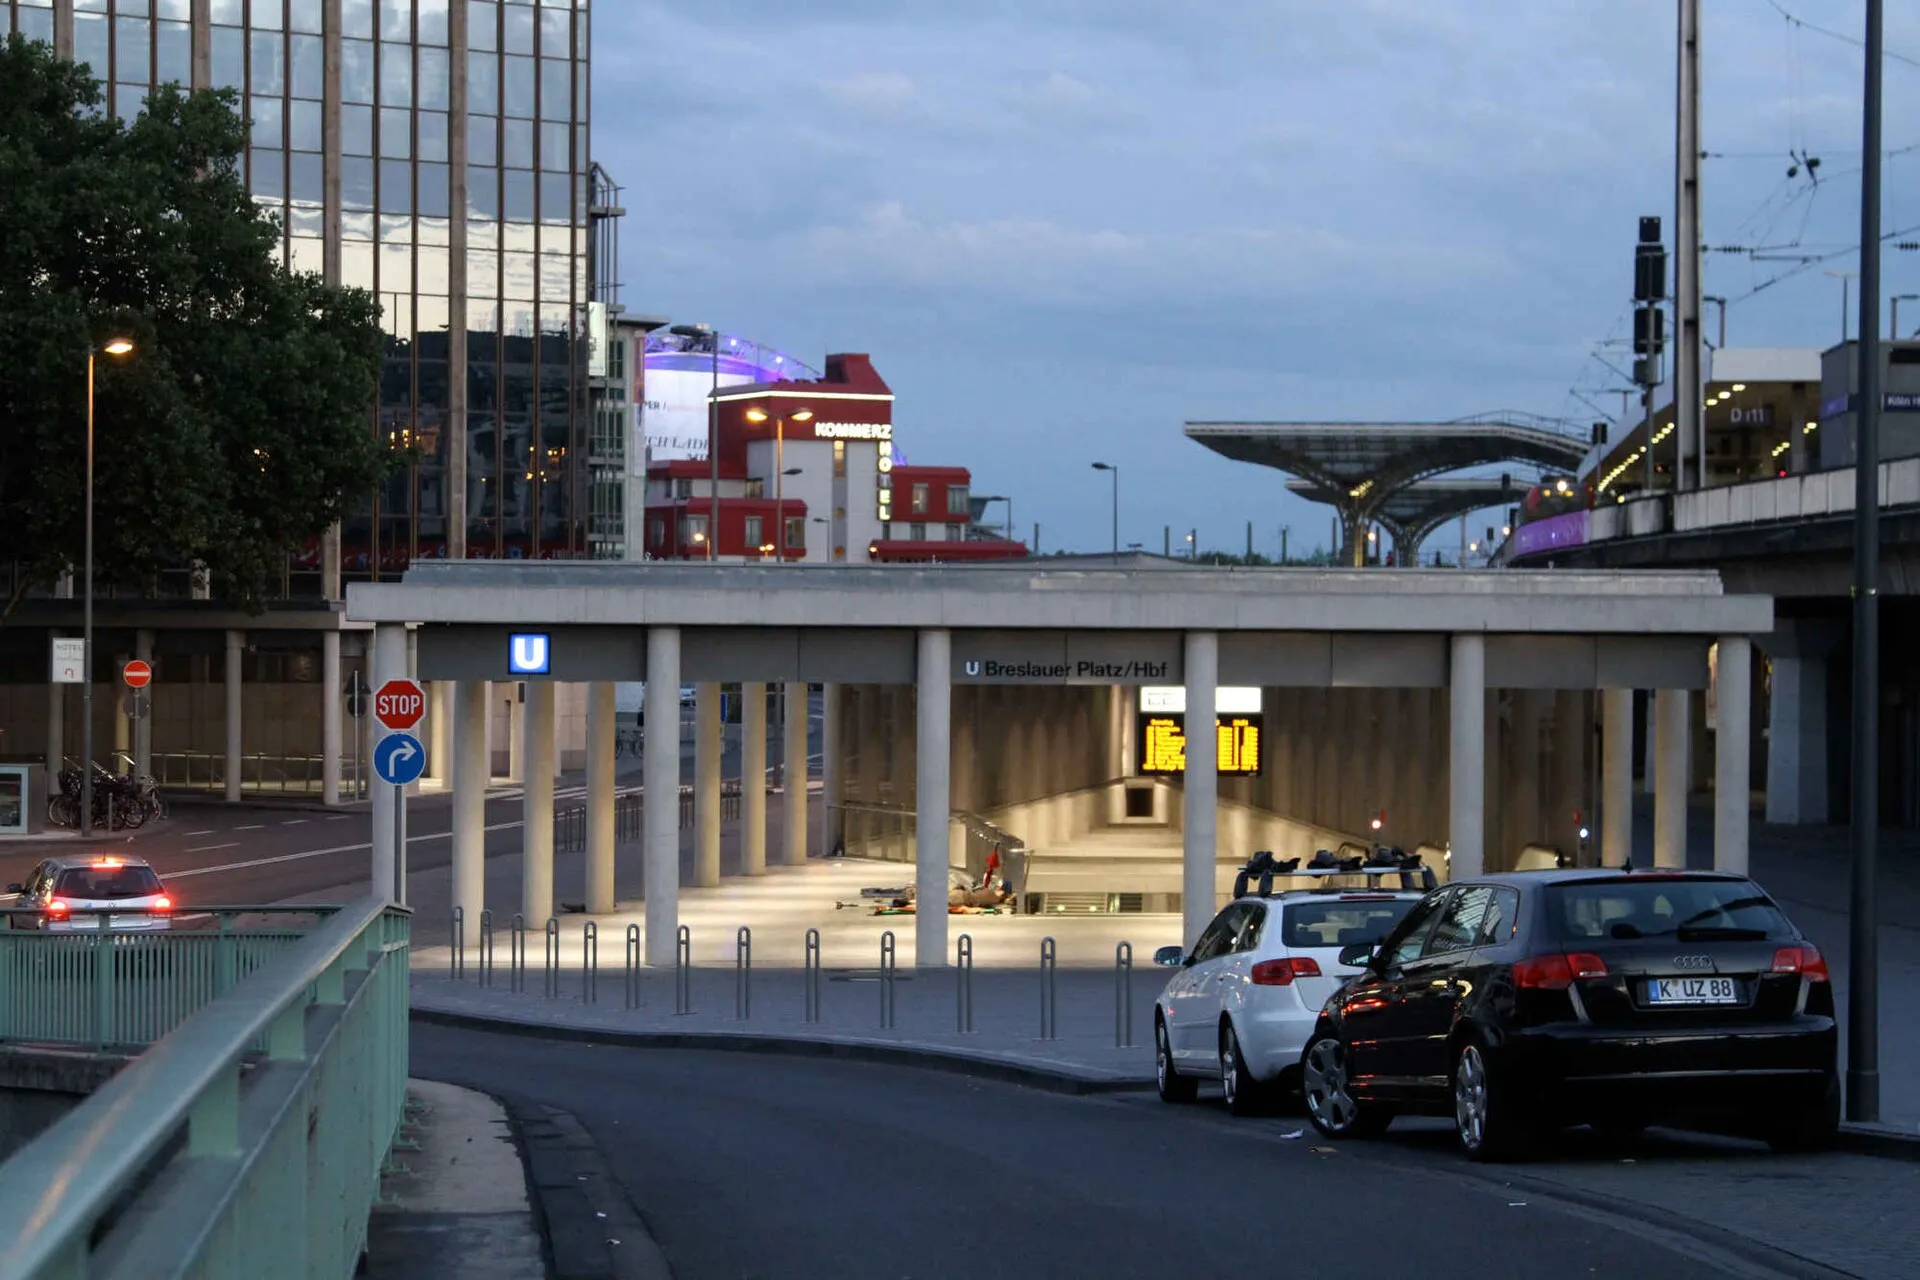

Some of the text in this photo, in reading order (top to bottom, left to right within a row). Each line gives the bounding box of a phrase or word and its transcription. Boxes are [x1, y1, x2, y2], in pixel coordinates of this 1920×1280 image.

[815, 422, 892, 439] KOMMERZ
[878, 440, 892, 520] HOTEL
[514, 637, 545, 670] U
[965, 661, 1168, 677] U Breslauer Platz/Hbf
[379, 694, 420, 715] STOP
[1660, 980, 1732, 997] K UZ 88
